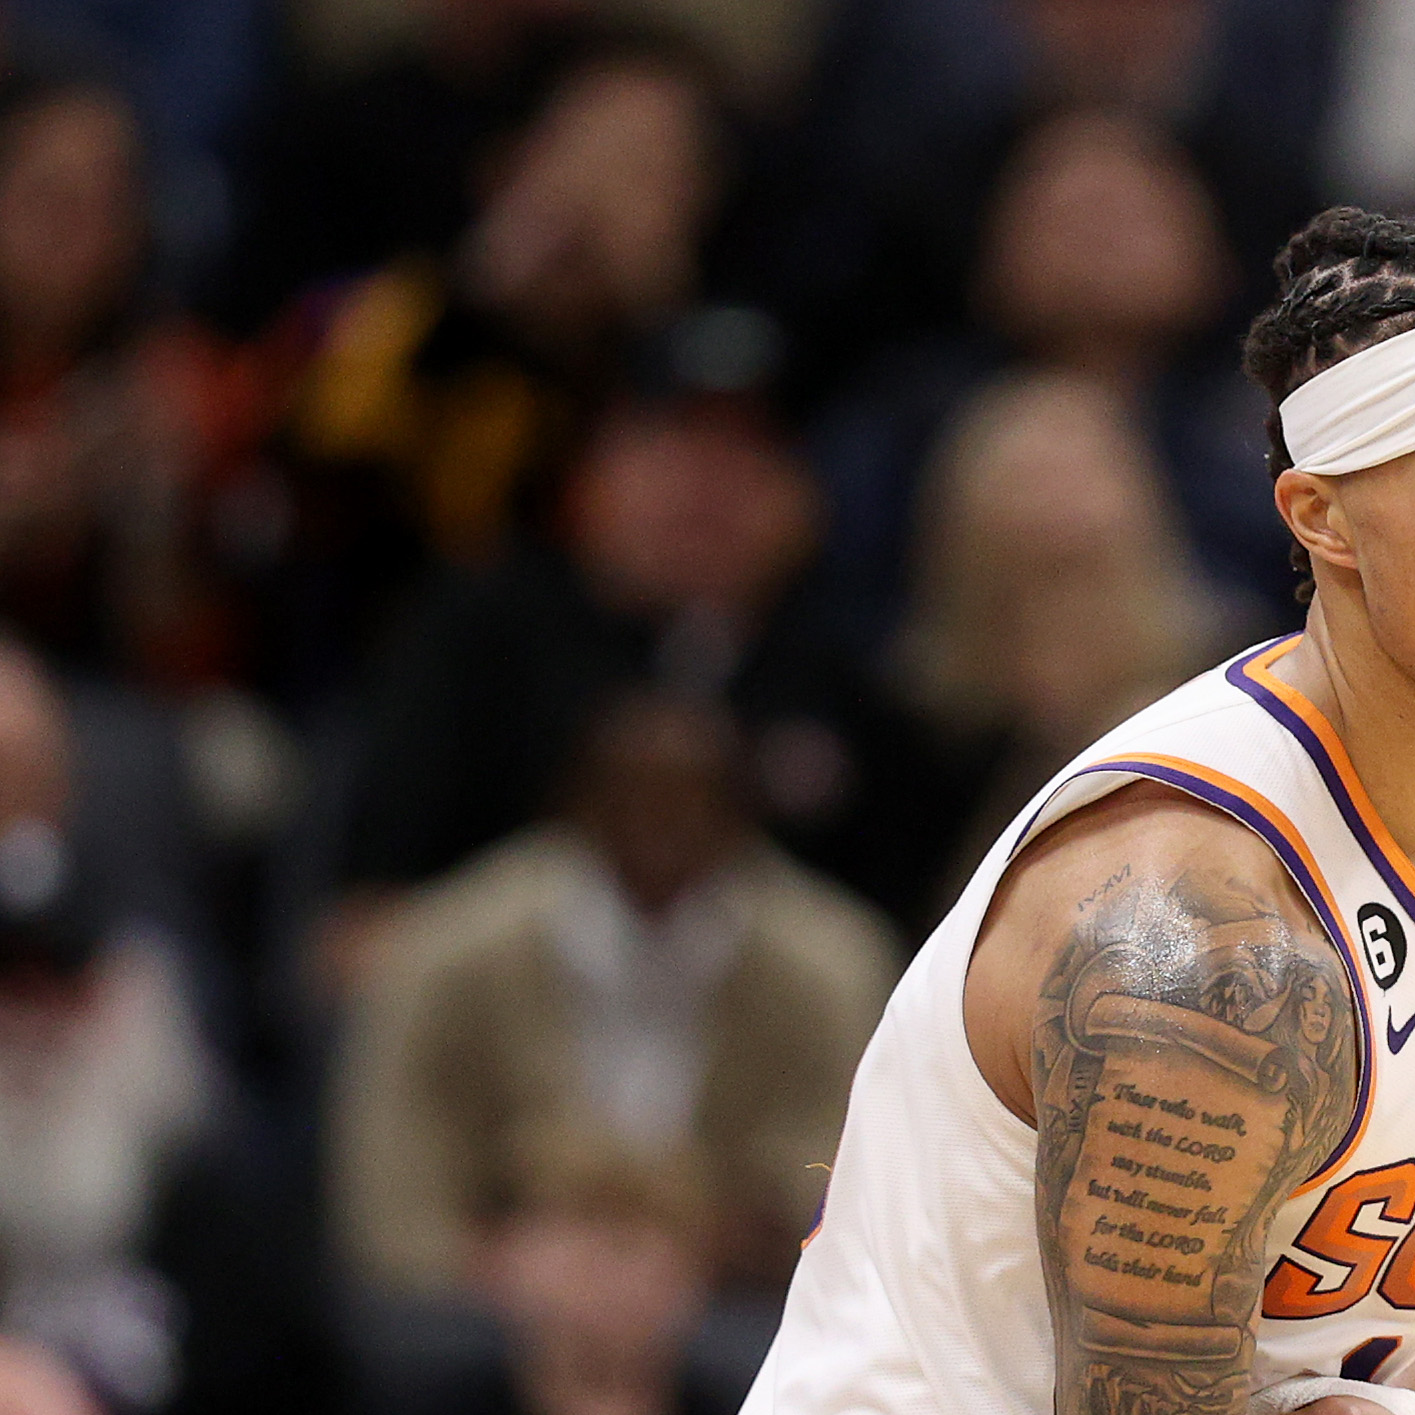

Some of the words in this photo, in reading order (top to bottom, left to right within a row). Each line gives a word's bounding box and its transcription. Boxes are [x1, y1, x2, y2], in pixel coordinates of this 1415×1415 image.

[1362, 913, 1397, 980] 6
[1145, 1127, 1173, 1147] the
[1174, 1136, 1236, 1164] LORD
[1090, 1214, 1118, 1236] for
